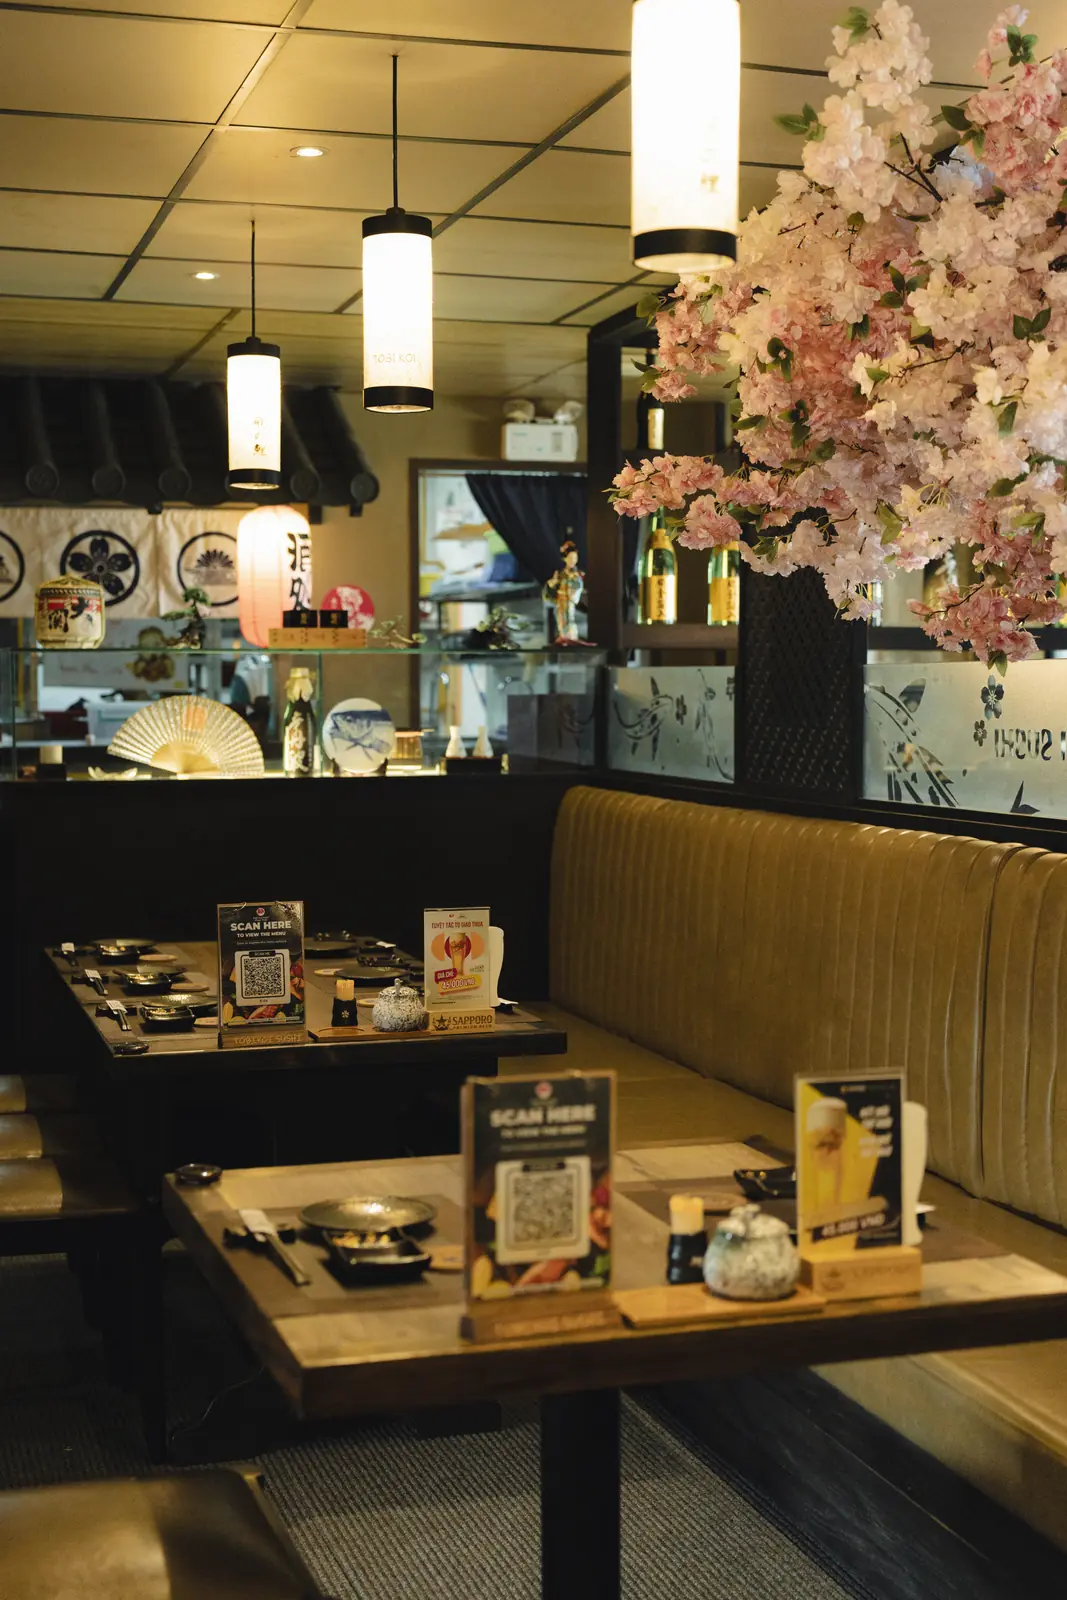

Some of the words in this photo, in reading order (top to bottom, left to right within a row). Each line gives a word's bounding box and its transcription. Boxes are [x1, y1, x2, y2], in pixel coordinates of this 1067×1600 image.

[373, 352, 396, 363] TOBI
[399, 353, 416, 363] KOI
[230, 922, 260, 931] SCAN
[263, 920, 292, 930] HERE
[452, 1014, 493, 1025] SAPPORO
[275, 1033, 302, 1043] SUSHI
[489, 1108, 543, 1127] SCAN
[546, 1103, 596, 1123] HERE
